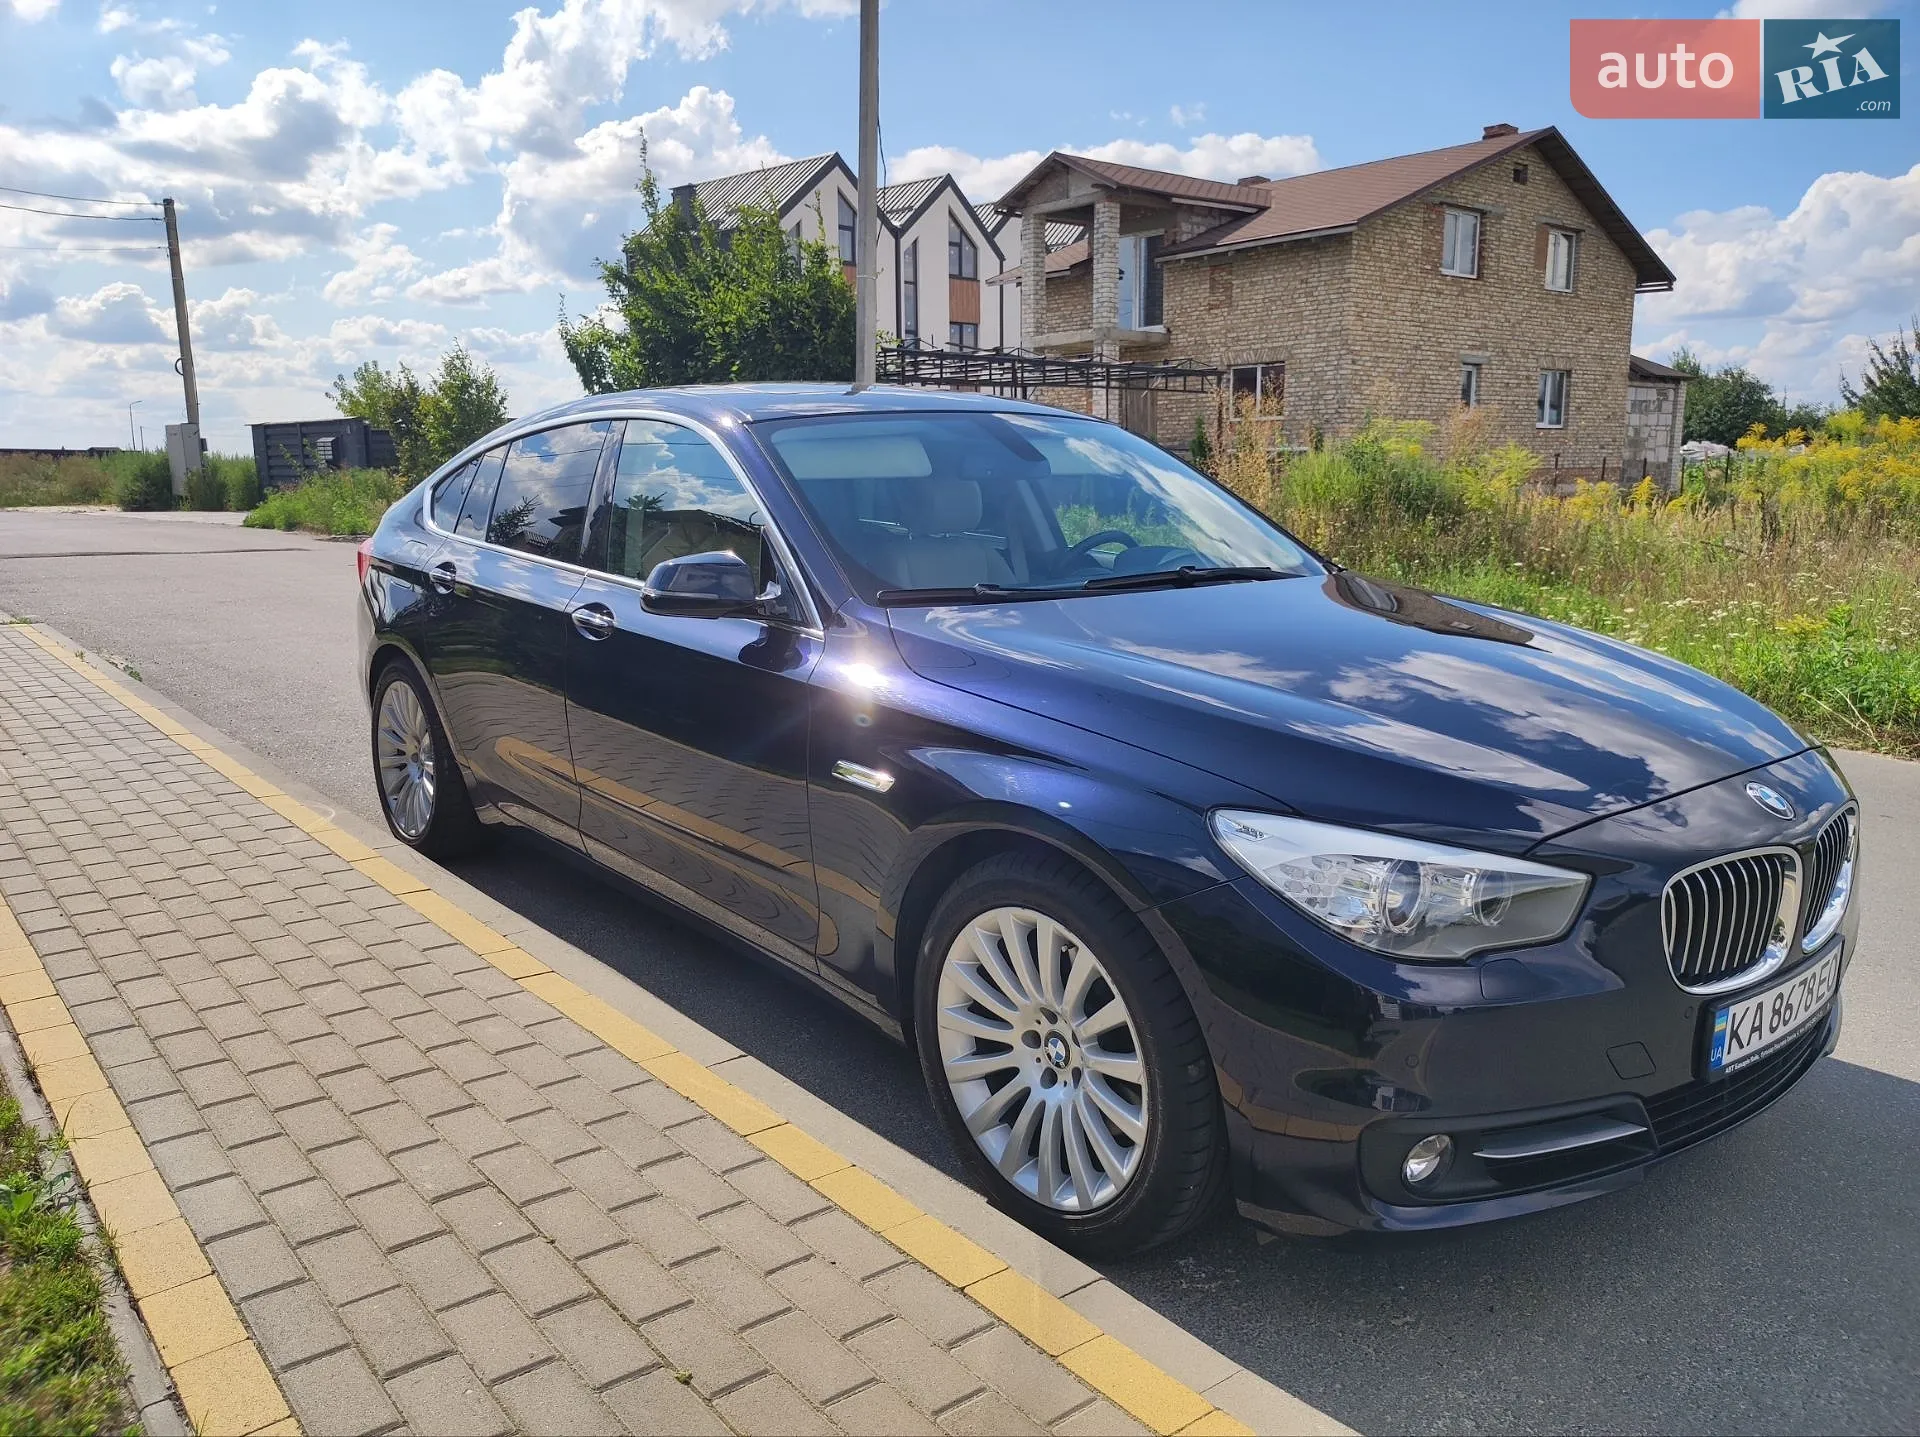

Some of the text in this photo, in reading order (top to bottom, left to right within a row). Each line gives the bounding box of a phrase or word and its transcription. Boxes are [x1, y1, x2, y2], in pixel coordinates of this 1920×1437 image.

[1727, 1000, 1764, 1055] KA
[1769, 972, 1816, 1033] 8678
[1711, 1046, 1722, 1062] UA
